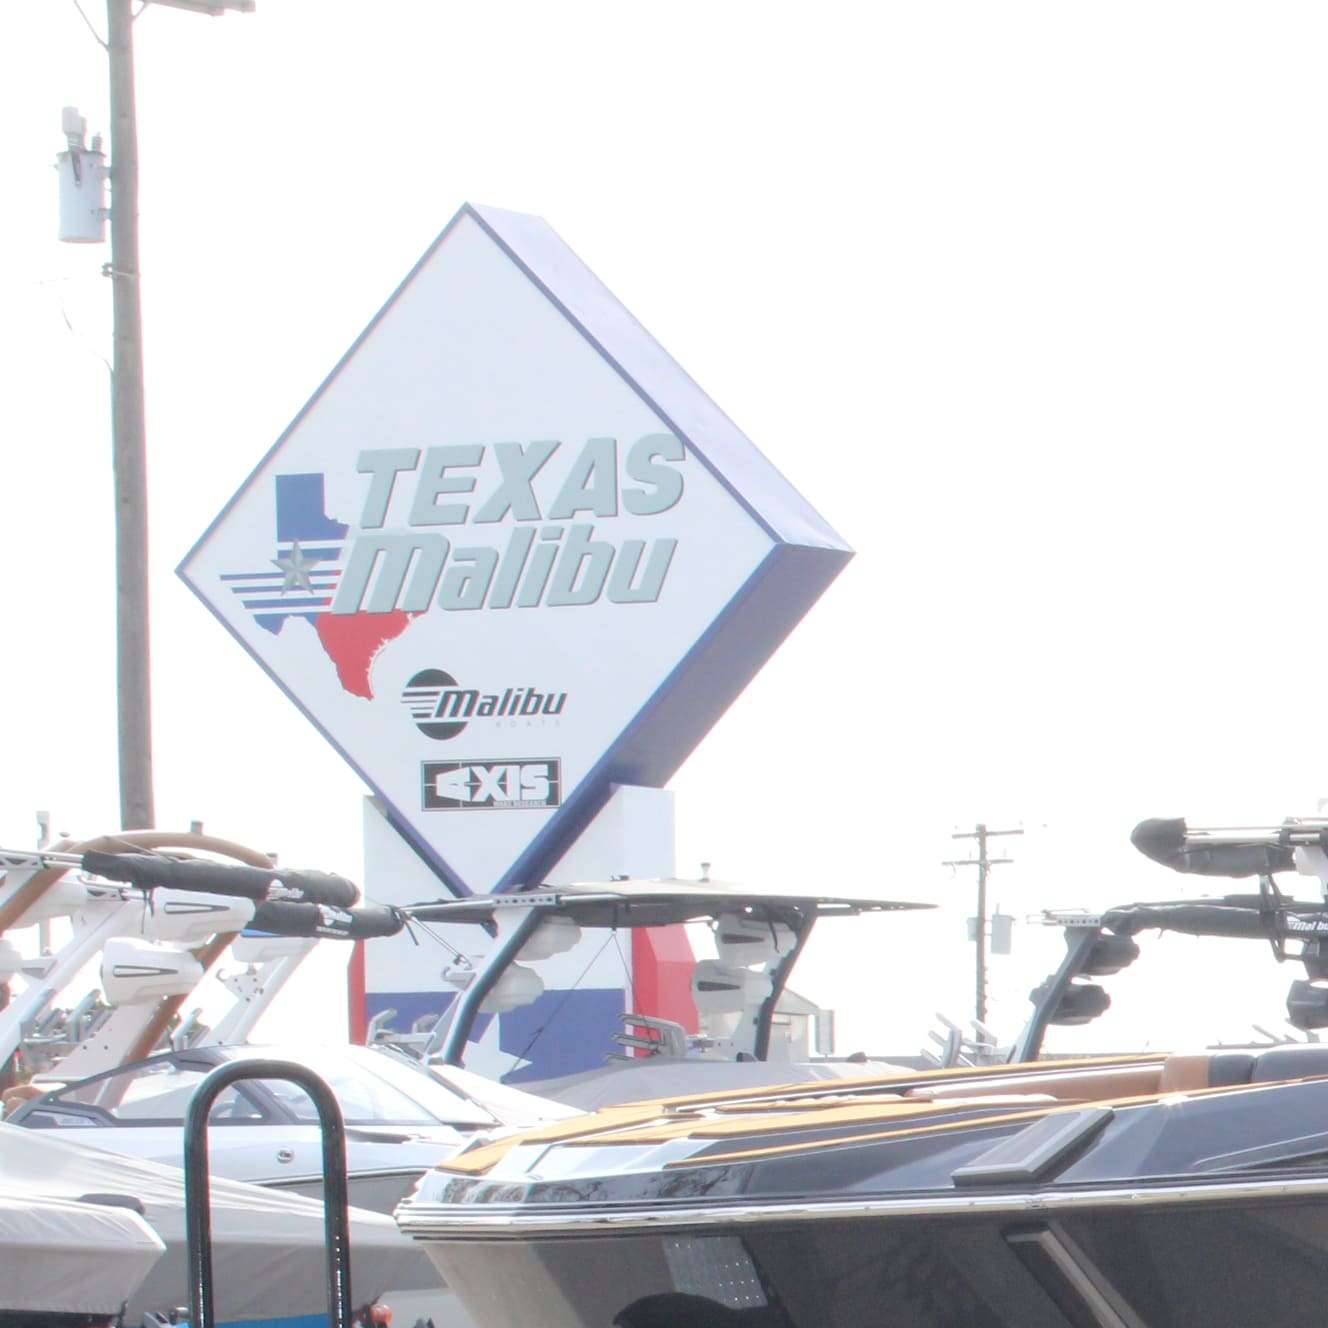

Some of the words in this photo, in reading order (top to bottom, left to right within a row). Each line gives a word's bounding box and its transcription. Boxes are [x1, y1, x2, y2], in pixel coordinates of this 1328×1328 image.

[356, 433, 686, 529] TEXAS
[331, 524, 678, 616] Malibu
[434, 688, 567, 718] Malibu
[436, 764, 549, 803] AXIS
